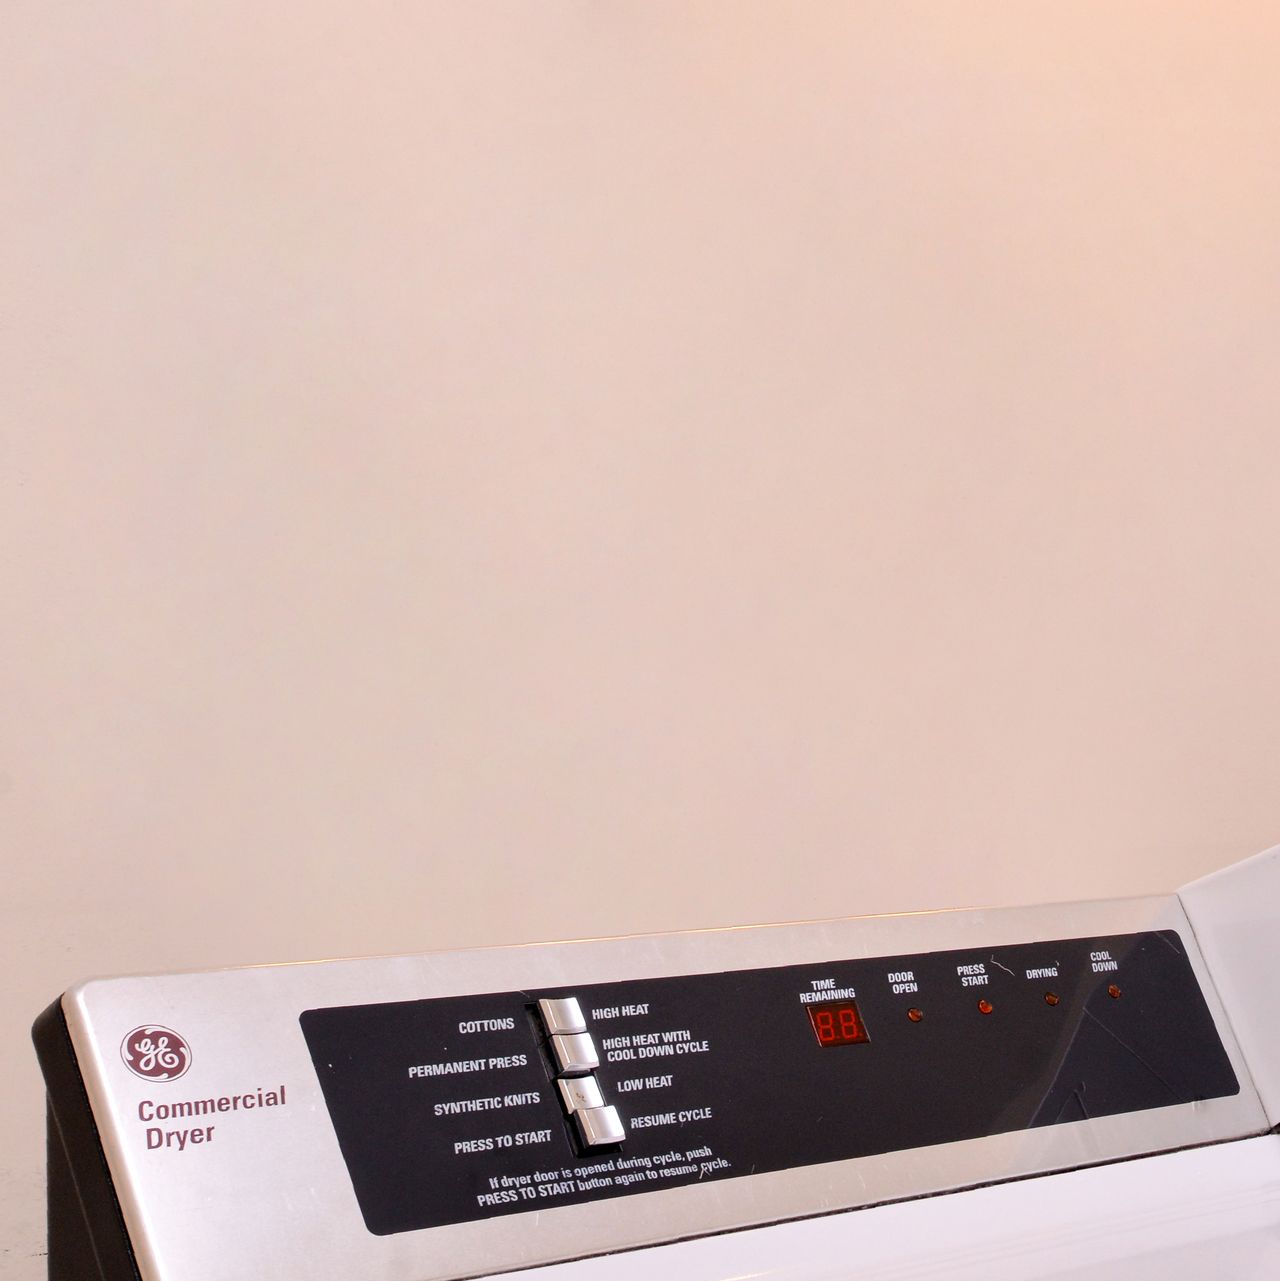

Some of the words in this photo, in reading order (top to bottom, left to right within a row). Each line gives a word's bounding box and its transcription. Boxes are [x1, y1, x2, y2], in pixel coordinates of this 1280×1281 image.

[1089, 951, 1112, 962] COOL
[956, 963, 986, 976] PRESS
[1025, 967, 1058, 980] DRYING
[1091, 961, 1118, 973] DOWN
[810, 978, 836, 991] TIME
[887, 971, 915, 983] DOOR
[961, 975, 989, 987] START
[799, 988, 856, 1004] REMAINING
[892, 982, 918, 994] OPEN
[591, 1007, 620, 1020] HIGH
[621, 1003, 650, 1017] HEAT
[458, 1017, 515, 1034] COTTONS
[602, 1036, 631, 1050] HIGH
[632, 1033, 660, 1046] HEAT
[661, 1029, 691, 1043] WITH
[607, 1049, 637, 1062] COOL
[638, 1045, 674, 1059] DOWN
[675, 1040, 710, 1055] CYCLE
[408, 1058, 486, 1079] PERMANENT
[488, 1054, 528, 1070] PRESS
[617, 1080, 644, 1093] LOW
[645, 1075, 674, 1089] HEAT
[138, 1085, 286, 1122] Commercial
[434, 1096, 502, 1116] SYNTHETIC
[504, 1092, 541, 1107] KNITS
[630, 1112, 678, 1129] RESUME
[678, 1107, 713, 1123] CYCLE
[146, 1126, 215, 1151] Dryer
[454, 1138, 494, 1154] PRESS
[495, 1134, 513, 1148] TO
[515, 1129, 552, 1146] START
[489, 1177, 499, 1190] If
[501, 1174, 532, 1188] dryer
[534, 1171, 560, 1182] door
[561, 1167, 573, 1179] is
[574, 1160, 615, 1178] opened
[616, 1157, 653, 1171] during
[652, 1151, 686, 1166] cycle,
[685, 1145, 713, 1161] push
[476, 1190, 518, 1207] PRESS
[519, 1186, 537, 1200] TO
[539, 1181, 576, 1197] START
[577, 1176, 614, 1191] button
[615, 1171, 646, 1186] again
[645, 1170, 658, 1180] to
[657, 1163, 699, 1178] resume
[700, 1158, 732, 1173] cycle.
